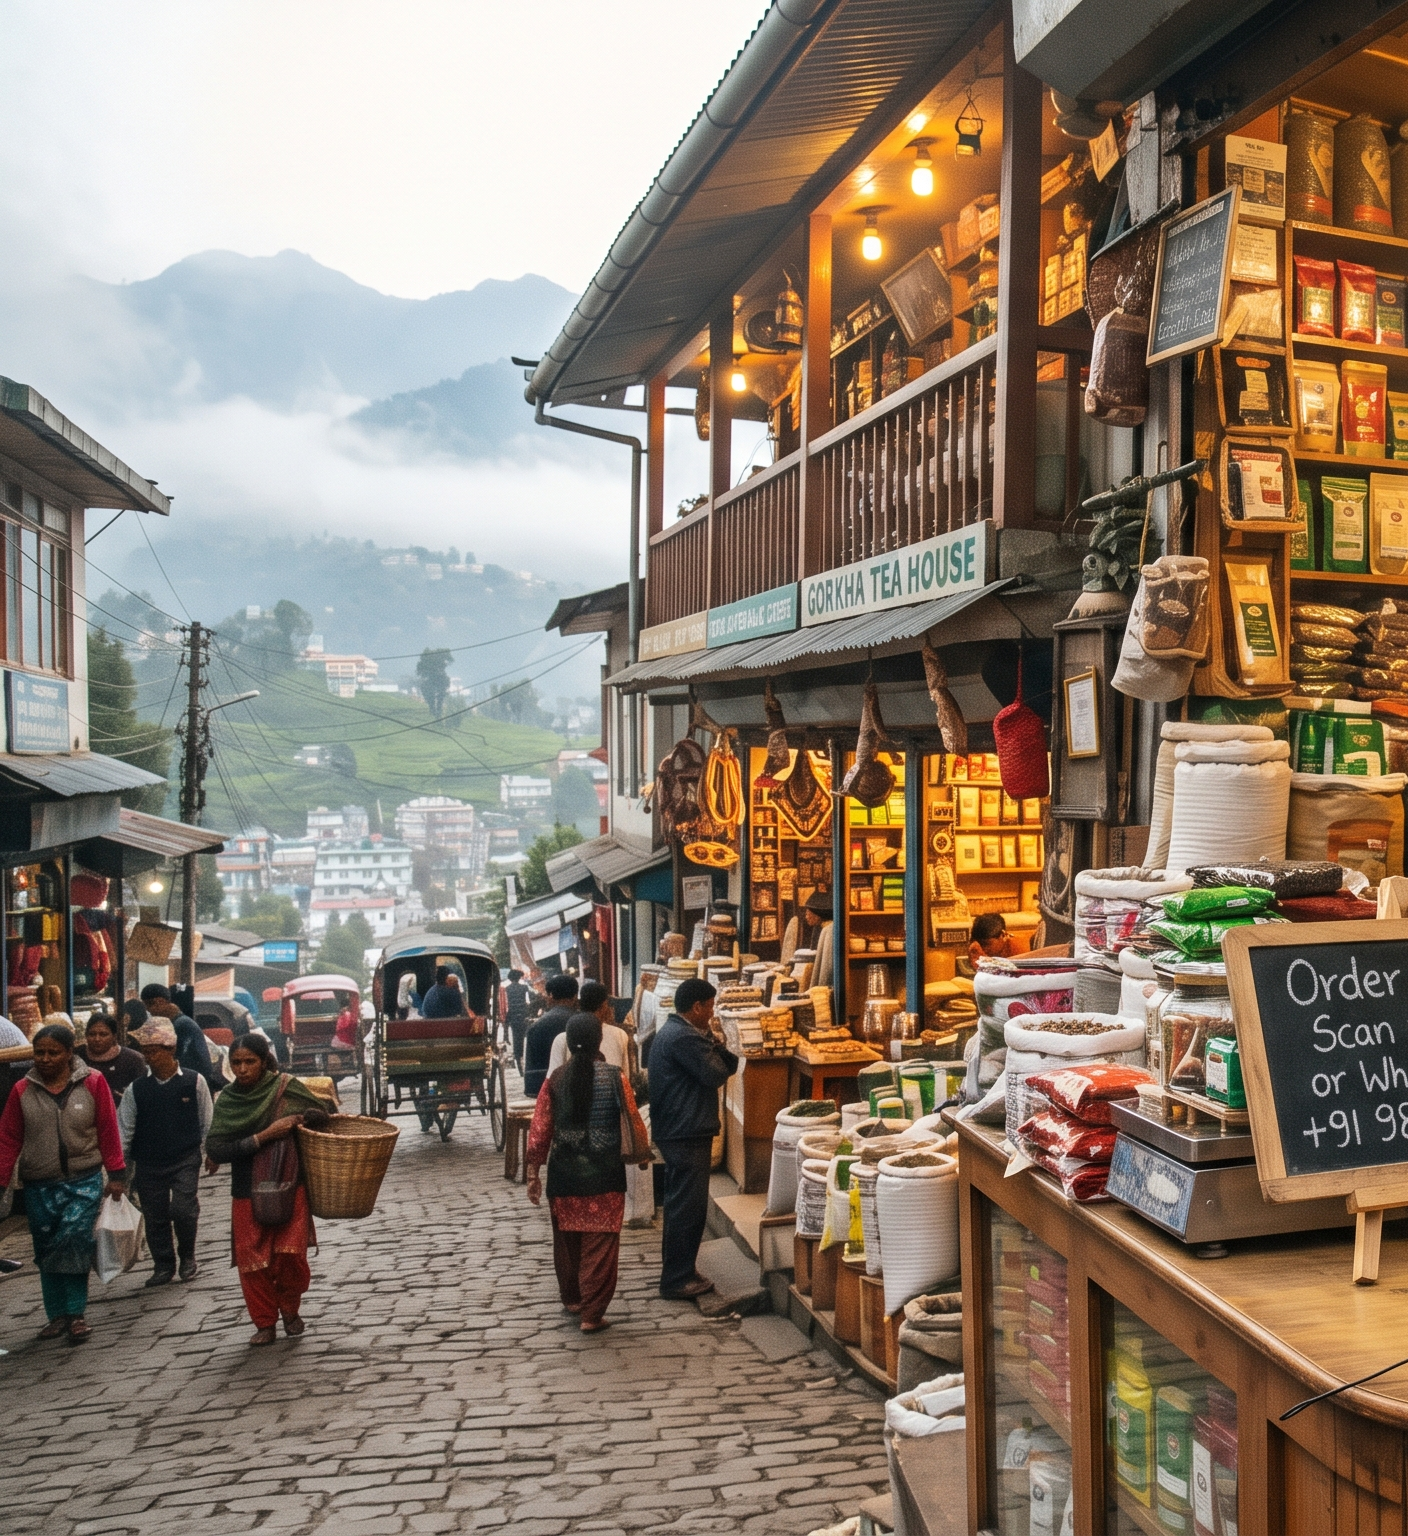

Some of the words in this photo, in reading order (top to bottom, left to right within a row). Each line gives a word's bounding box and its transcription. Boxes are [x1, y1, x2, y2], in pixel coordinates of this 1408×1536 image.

[807, 570, 866, 617] GORKHA
[869, 557, 902, 600] TEA
[907, 535, 976, 595] HOUSE
[1286, 956, 1400, 1006] Order
[1313, 1014, 1395, 1052] Scan
[1311, 1070, 1346, 1097] or
[1303, 1109, 1361, 1148] +91
